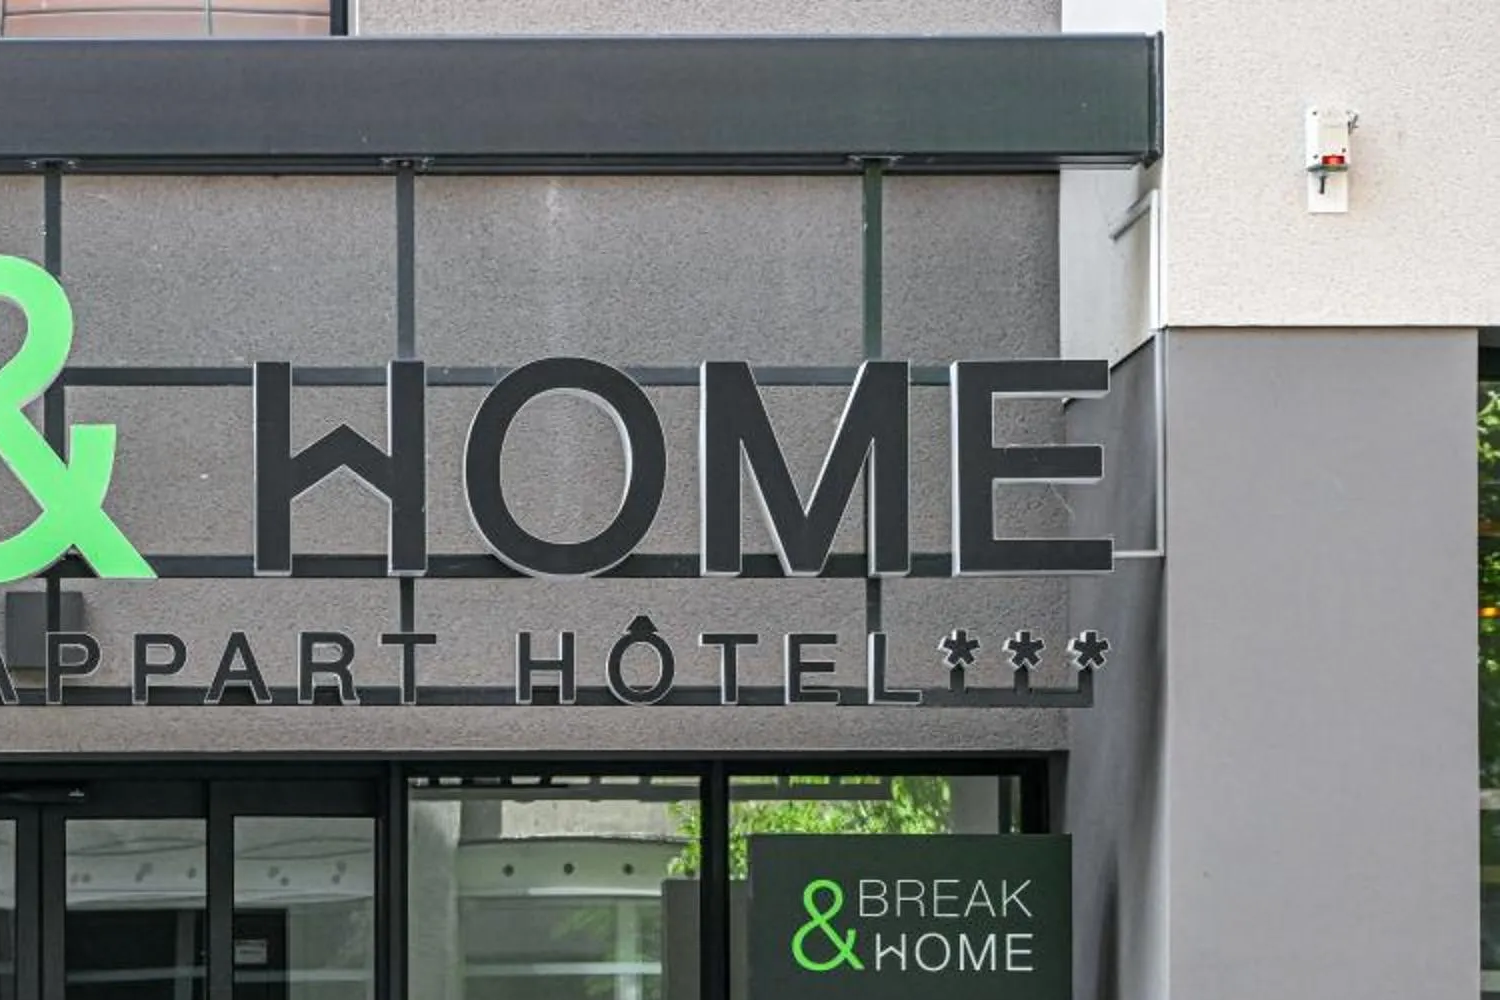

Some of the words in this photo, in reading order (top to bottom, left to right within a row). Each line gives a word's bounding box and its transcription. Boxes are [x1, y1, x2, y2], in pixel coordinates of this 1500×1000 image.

[253, 357, 1114, 580] HOME
[791, 879, 865, 972] &
[874, 932, 1034, 972] HOME
[858, 879, 1033, 918] BREAK
